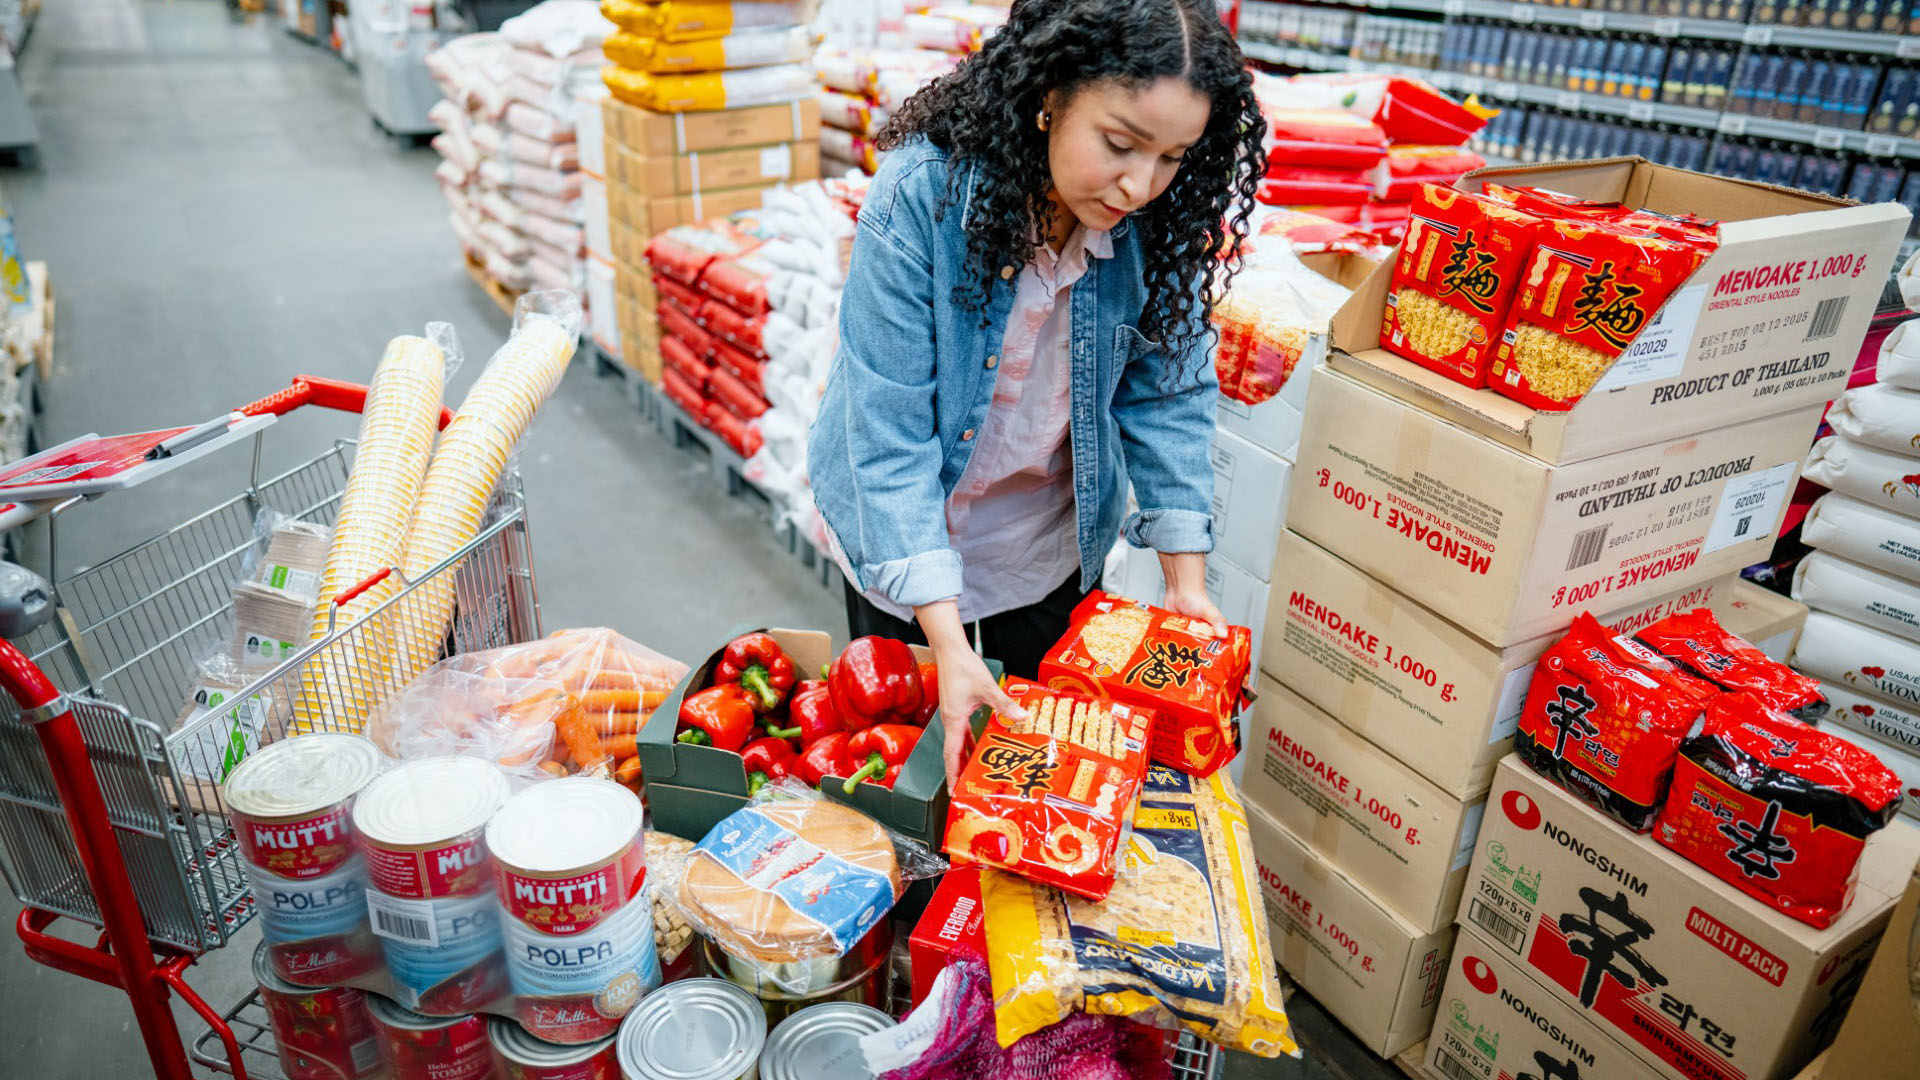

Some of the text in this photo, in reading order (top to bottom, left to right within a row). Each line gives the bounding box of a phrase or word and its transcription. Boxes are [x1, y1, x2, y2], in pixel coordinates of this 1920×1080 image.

[1545, 266, 1569, 313] MENDAKE
[1713, 253, 1867, 297] MENDAKE 1,000 g.
[1708, 288, 1801, 311] ORIENTAL STYLE NOODLES
[1699, 332, 1728, 348] BEST
[1752, 322, 1766, 335] 02
[1767, 318, 1780, 332] 12
[1782, 311, 1809, 328] 2025
[1651, 351, 1831, 404] PRODUCT OF THAILAND
[1753, 386, 1774, 398] 1,000
[1782, 381, 1796, 393] (35
[1816, 373, 1826, 382] 10
[1827, 369, 1846, 380] Packs
[1316, 467, 1332, 488] g.
[1640, 466, 1661, 480] 1,000
[1660, 475, 1682, 495] OF
[1684, 455, 1755, 489] PRODUCT
[1333, 481, 1383, 519] 1,000
[1556, 489, 1578, 502] Packs
[1579, 484, 1657, 518] THAILAND
[1734, 491, 1766, 510] 102029
[1386, 492, 1496, 553] ORIENTAL STYLE NOODLES
[1650, 521, 1664, 533] 02
[1686, 505, 1711, 522] BEST
[1386, 507, 1492, 575] MENDAKE
[1608, 530, 1634, 549] 2025
[1636, 526, 1649, 539] 12
[1887, 540, 1920, 556] NET WEIG
[1619, 536, 1704, 569] ORIENTAL STYLE NOODLES
[1552, 548, 1700, 609] MENDAKE 1,000 g.
[1606, 604, 1664, 634] NDAKE
[1664, 588, 1703, 615] 1,000
[1873, 601, 1915, 619] NET WEIGHT
[1286, 608, 1319, 633] ORIENTAL
[1321, 623, 1343, 647] STYLE
[1343, 643, 1379, 669] NOODLES
[1289, 591, 1379, 654] MENDAKE
[1383, 645, 1437, 687] 1,000
[1440, 683, 1458, 702] g.
[1547, 684, 1600, 760] 辛
[1871, 718, 1920, 748] WOND
[1583, 738, 1621, 768] 라면
[1269, 727, 1349, 794] MENDAKE
[1354, 786, 1402, 830] 1,000
[1405, 826, 1421, 846] g.
[1166, 811, 1193, 828] 5kg
[1691, 791, 1734, 822] 라면
[254, 816, 350, 849] MUTTI
[1717, 799, 1797, 880] 辛
[1543, 821, 1649, 898] NONGSHIM
[273, 880, 361, 910] POLPA
[515, 875, 607, 905] MUTTI
[938, 896, 977, 942] EVERGOOD
[527, 940, 613, 966] POLPA
[1316, 911, 1359, 956] 1,000
[1361, 955, 1376, 974] g.
[1559, 886, 1668, 1010] 辛
[1690, 912, 1782, 983] MULTI PACK
[1500, 988, 1596, 1068] NONGSHIM
[1659, 993, 1737, 1058] 라면
[1633, 1014, 1724, 1080] SHIN RAMYUN
